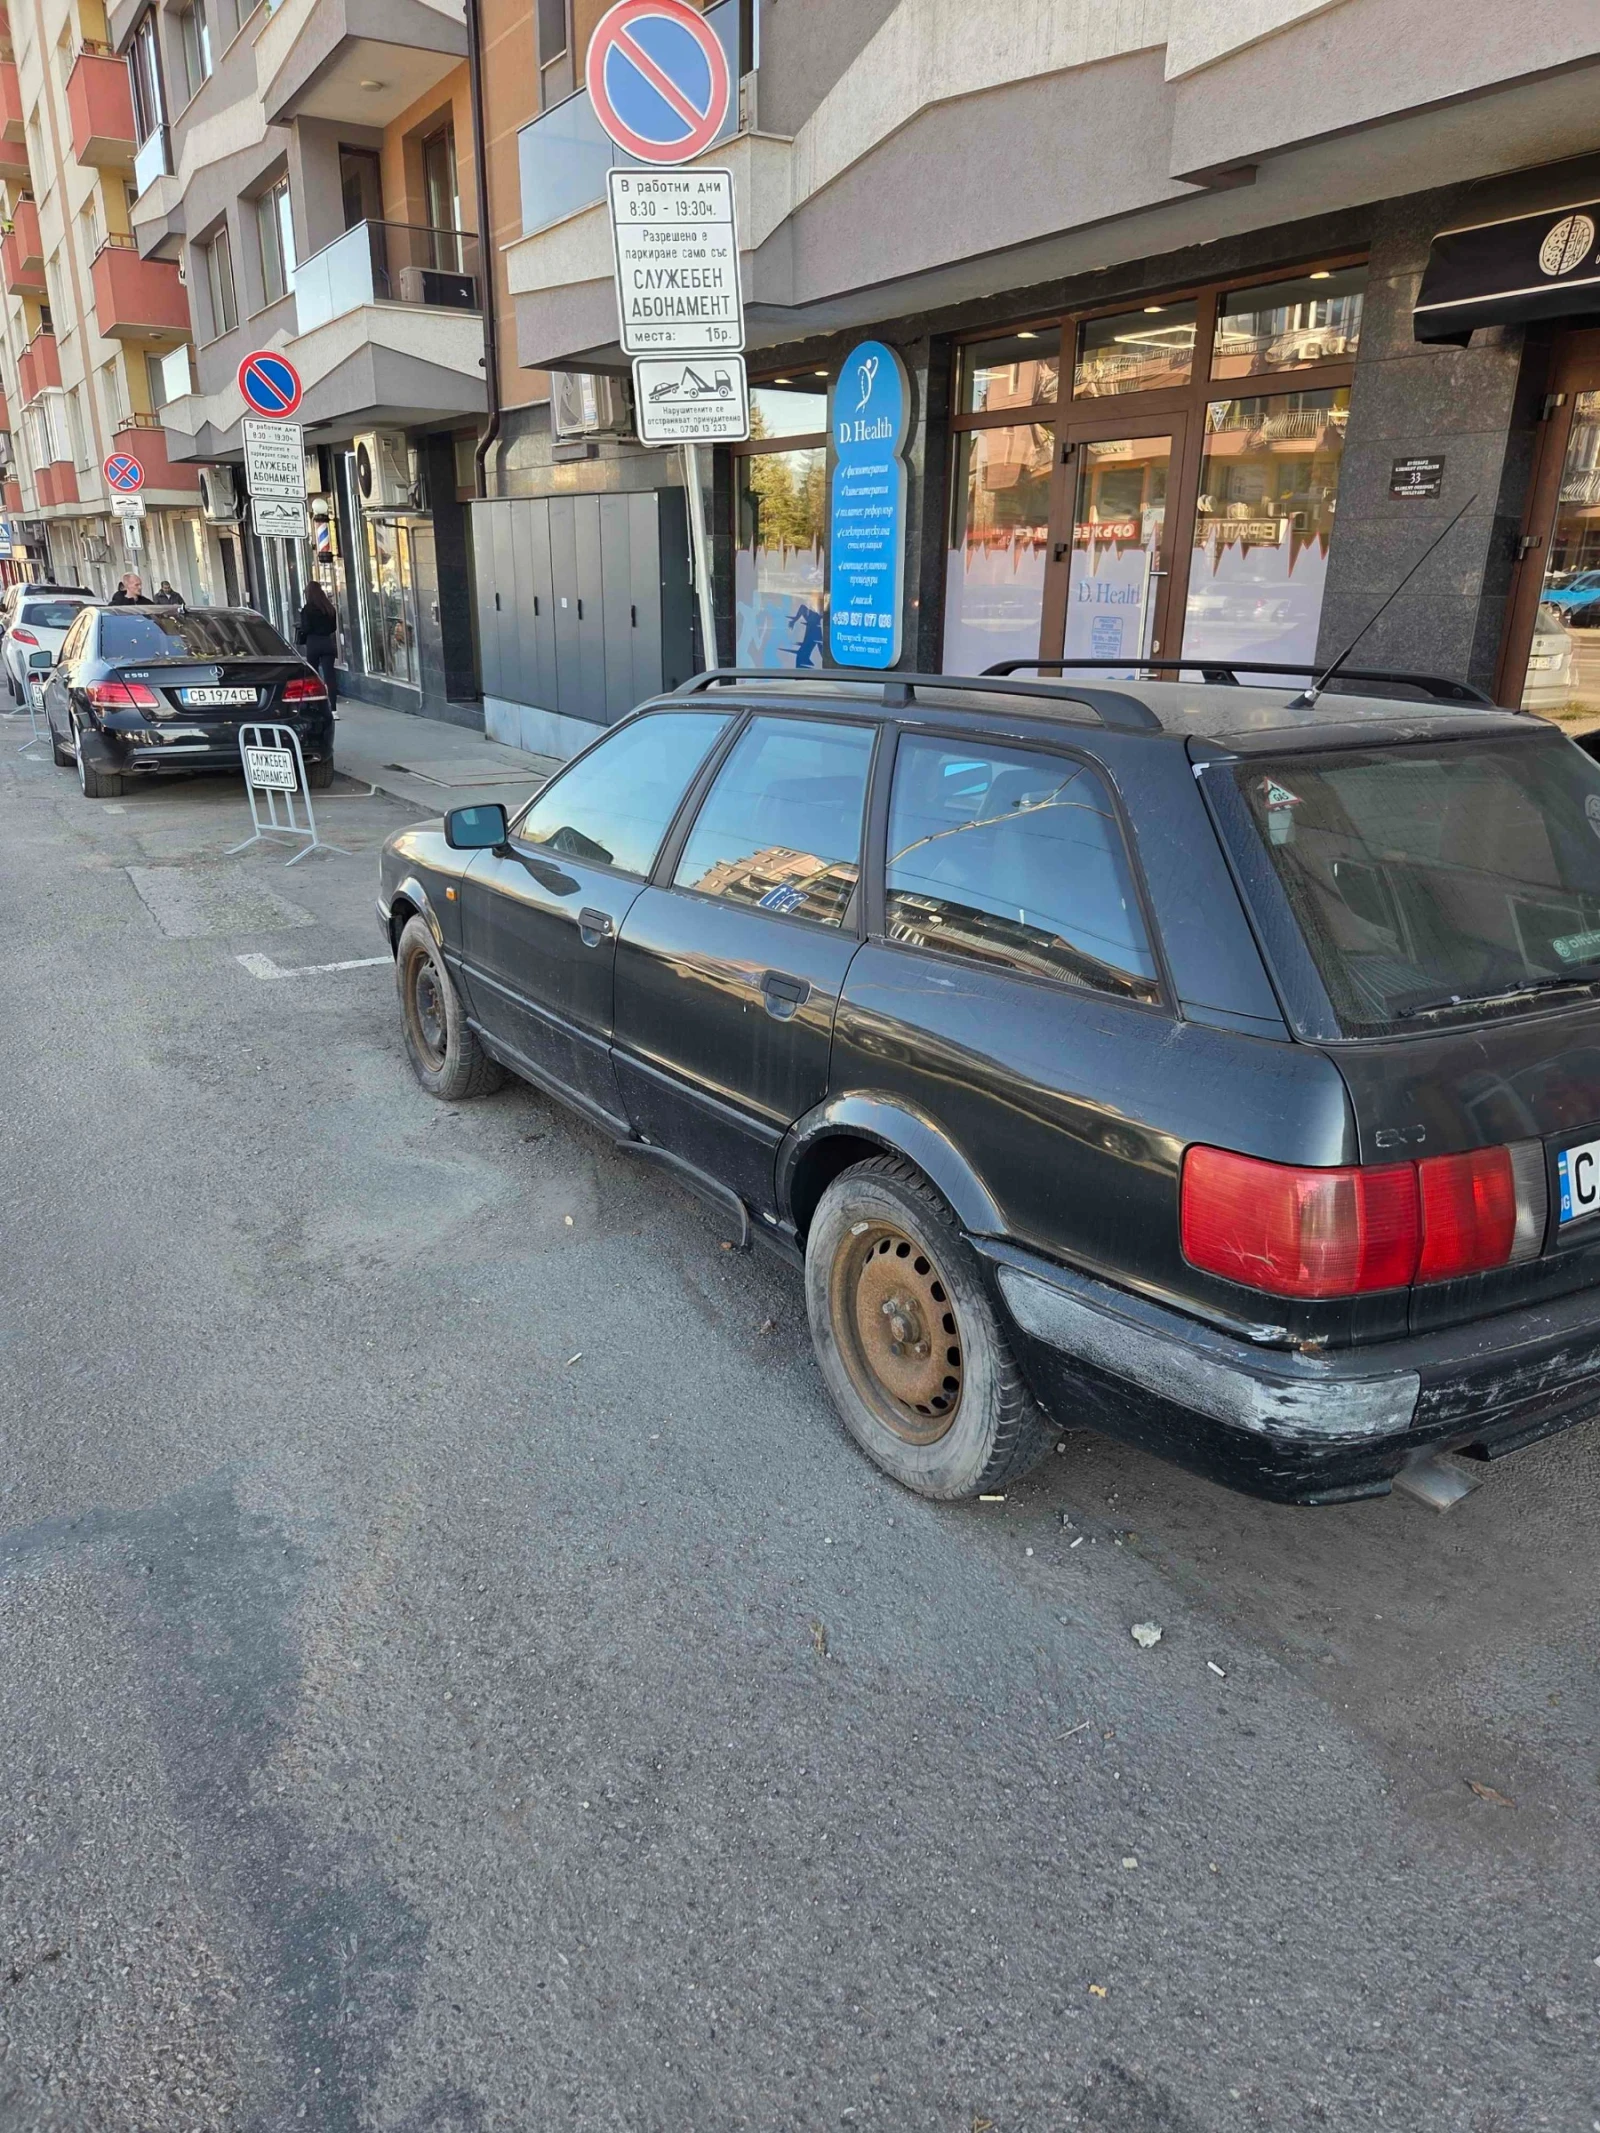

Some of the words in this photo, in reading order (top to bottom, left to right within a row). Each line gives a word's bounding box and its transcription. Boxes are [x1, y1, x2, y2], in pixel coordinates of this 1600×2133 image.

[621, 179, 630, 193] В
[637, 180, 690, 196] работни
[698, 181, 721, 194] дни
[630, 201, 656, 217] 8:30
[675, 200, 717, 217] 19:30ч.
[643, 229, 697, 245] Разрешено
[701, 232, 708, 242] е
[625, 247, 678, 261] паркиране
[682, 248, 706, 259] само
[710, 247, 728, 258] със
[633, 268, 723, 290] СЛУЖЕБЕН
[632, 295, 730, 318] АБОНАМЕНТ
[635, 330, 676, 343] места:
[663, 406, 713, 416] Нарушителите
[647, 417, 690, 426] отстраняват
[693, 415, 741, 425] принудително
[680, 425, 699, 433] 0700
[703, 424, 710, 432] 13
[713, 424, 727, 432] 233
[839, 422, 852, 444] D.
[854, 416, 893, 441] Health
[254, 460, 297, 472] СЛУЖЕБЕН
[254, 472, 300, 484] АБОНАМЕНТ
[1410, 472, 1421, 484] 33
[285, 487, 289, 495] 2
[1078, 582, 1092, 603] D.
[190, 690, 206, 701] CB
[211, 690, 237, 701] 1974
[239, 690, 255, 700] CE
[251, 753, 288, 768] СЛУЖЕБЕН
[253, 769, 292, 784] АБОНАМЕНТ
[1273, 792, 1289, 801] GAS
[1575, 1152, 1600, 1205] C
[1561, 1194, 1571, 1212] G
